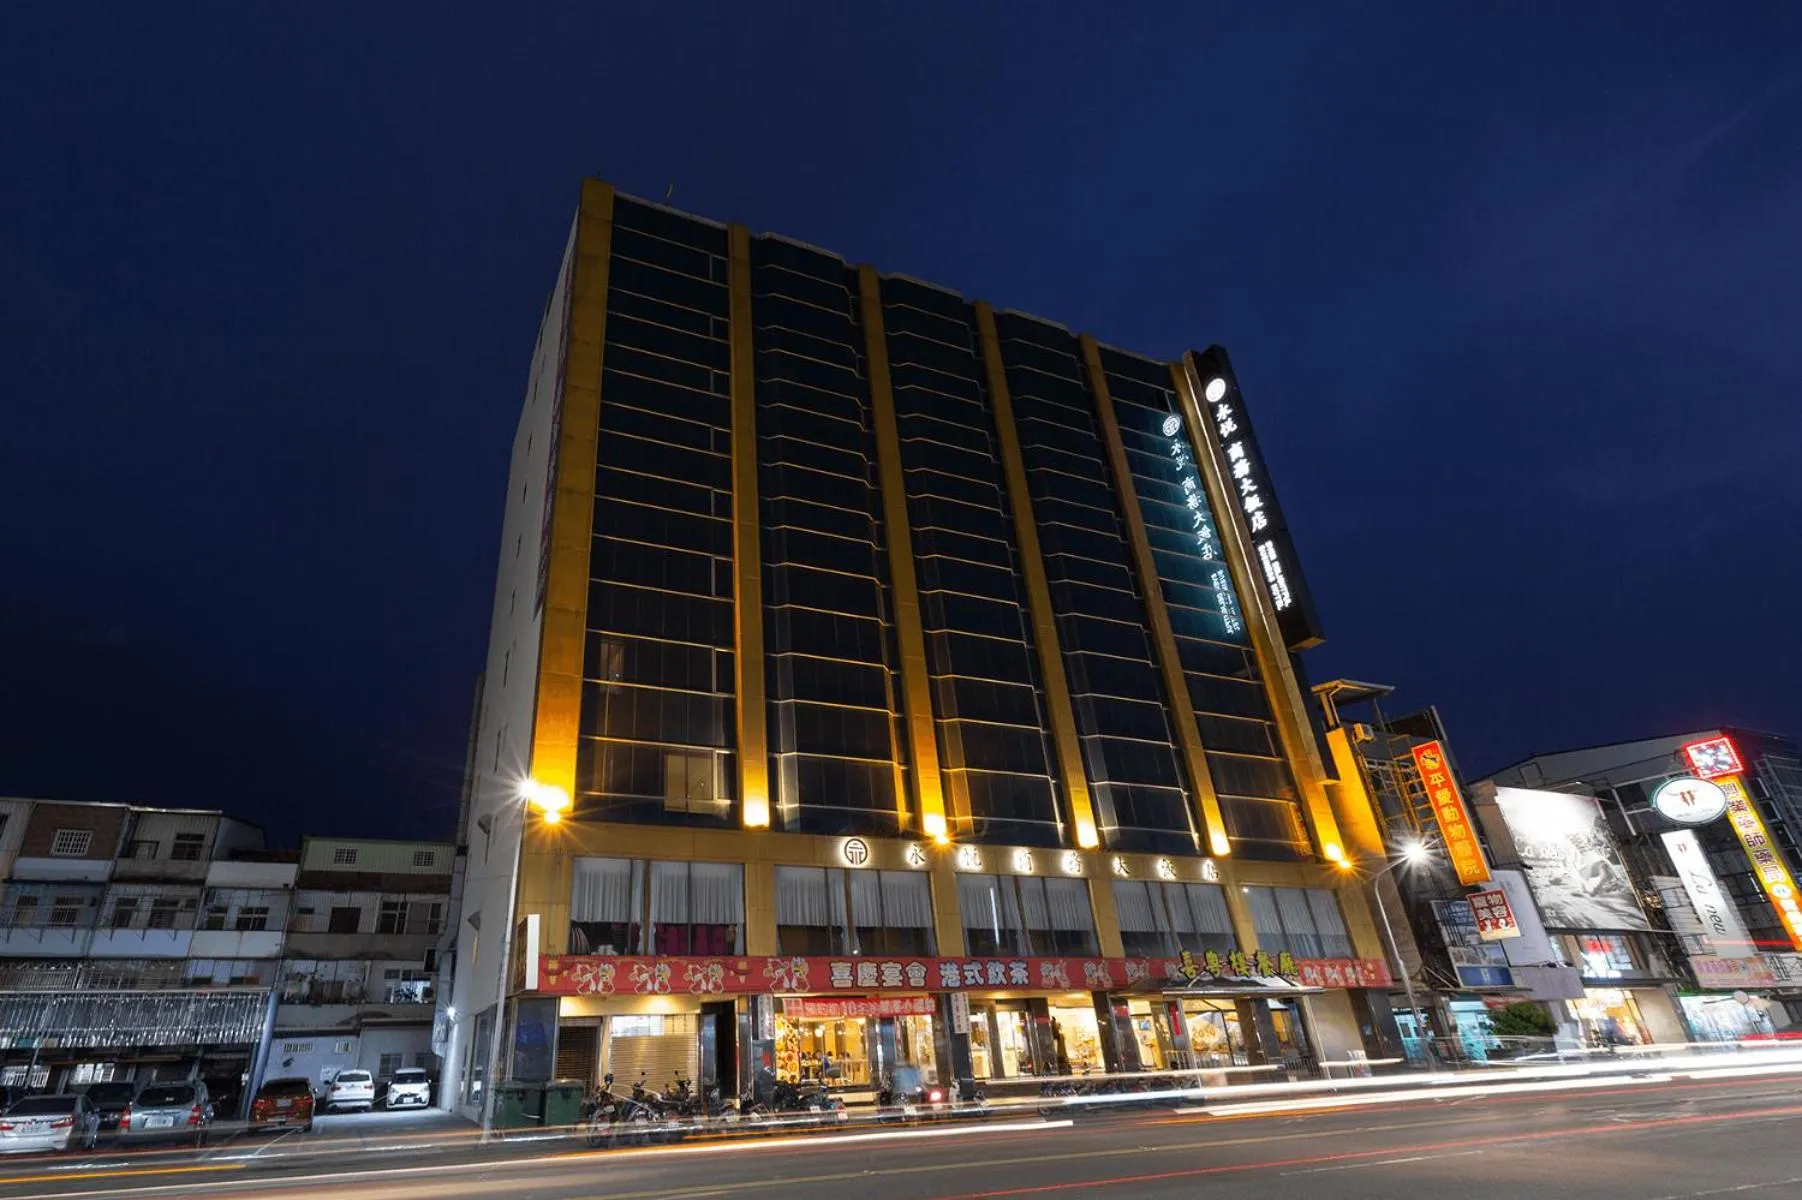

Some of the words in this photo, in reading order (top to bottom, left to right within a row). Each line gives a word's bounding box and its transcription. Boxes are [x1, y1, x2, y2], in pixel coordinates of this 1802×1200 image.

[1703, 903, 1728, 936] new
[829, 961, 928, 988] 喜慶宴會
[939, 961, 1030, 988] 港式飲茶
